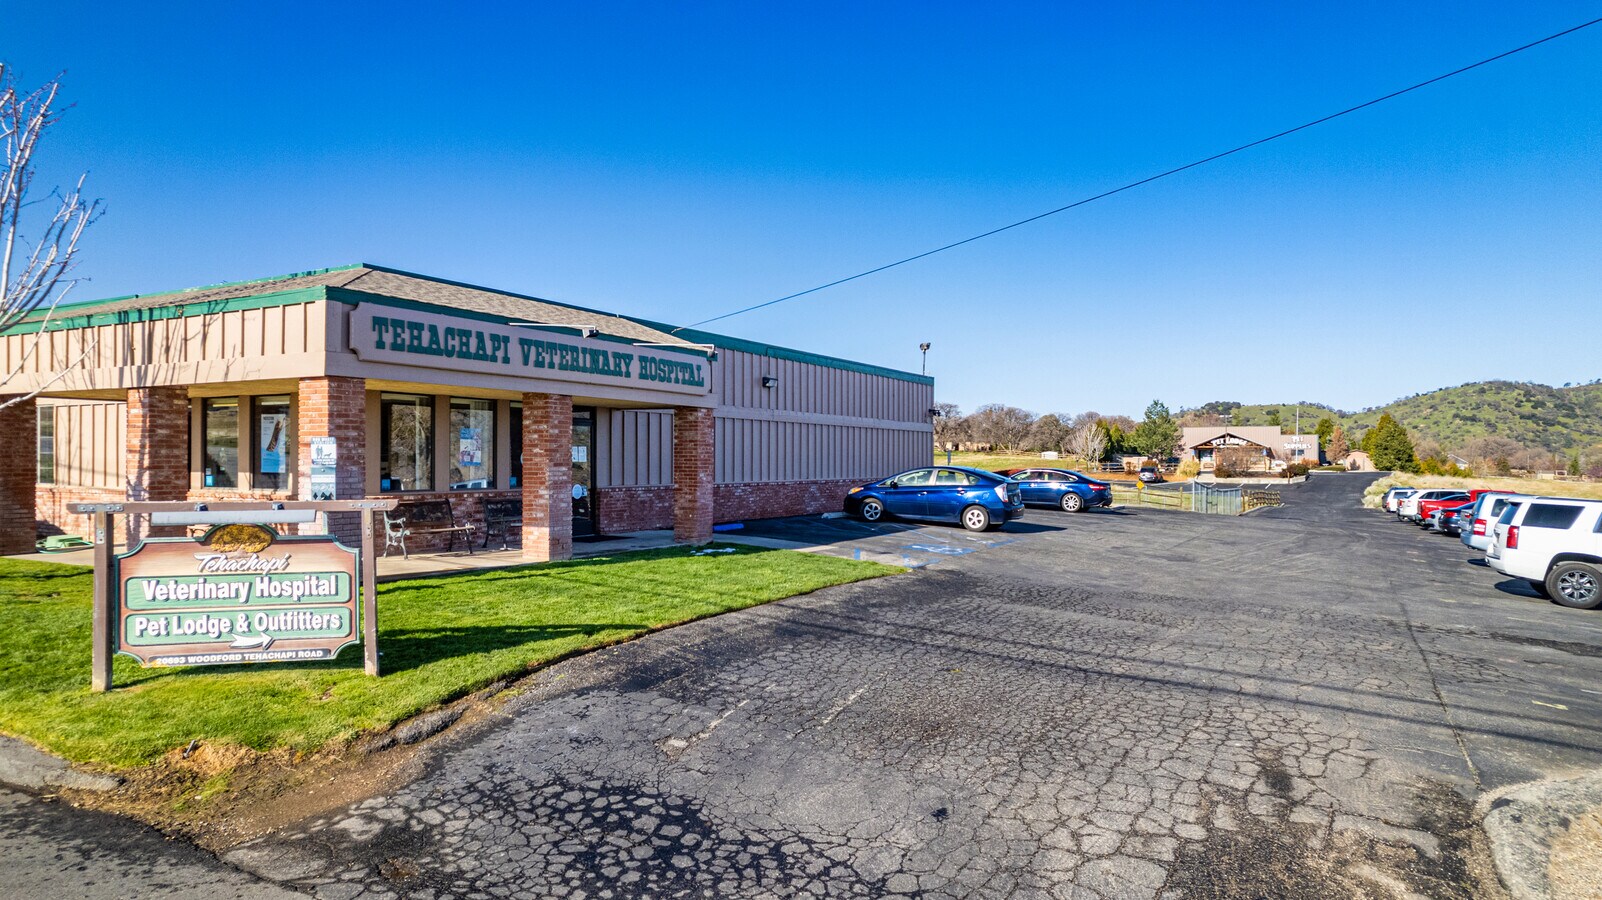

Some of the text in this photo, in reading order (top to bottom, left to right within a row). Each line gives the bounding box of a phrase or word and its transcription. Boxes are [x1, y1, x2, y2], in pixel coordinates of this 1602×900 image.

[372, 315, 705, 387] TEHACHAPI VETERINARY HOSPITAL
[194, 553, 290, 573] Tehachapi
[142, 575, 337, 603] Veterinary Hospital
[135, 610, 342, 638] Pet Lodge & Outfitters
[187, 653, 242, 663] WOODFORD
[243, 651, 296, 660] TEHACHAPI
[298, 650, 323, 658] ROAD
